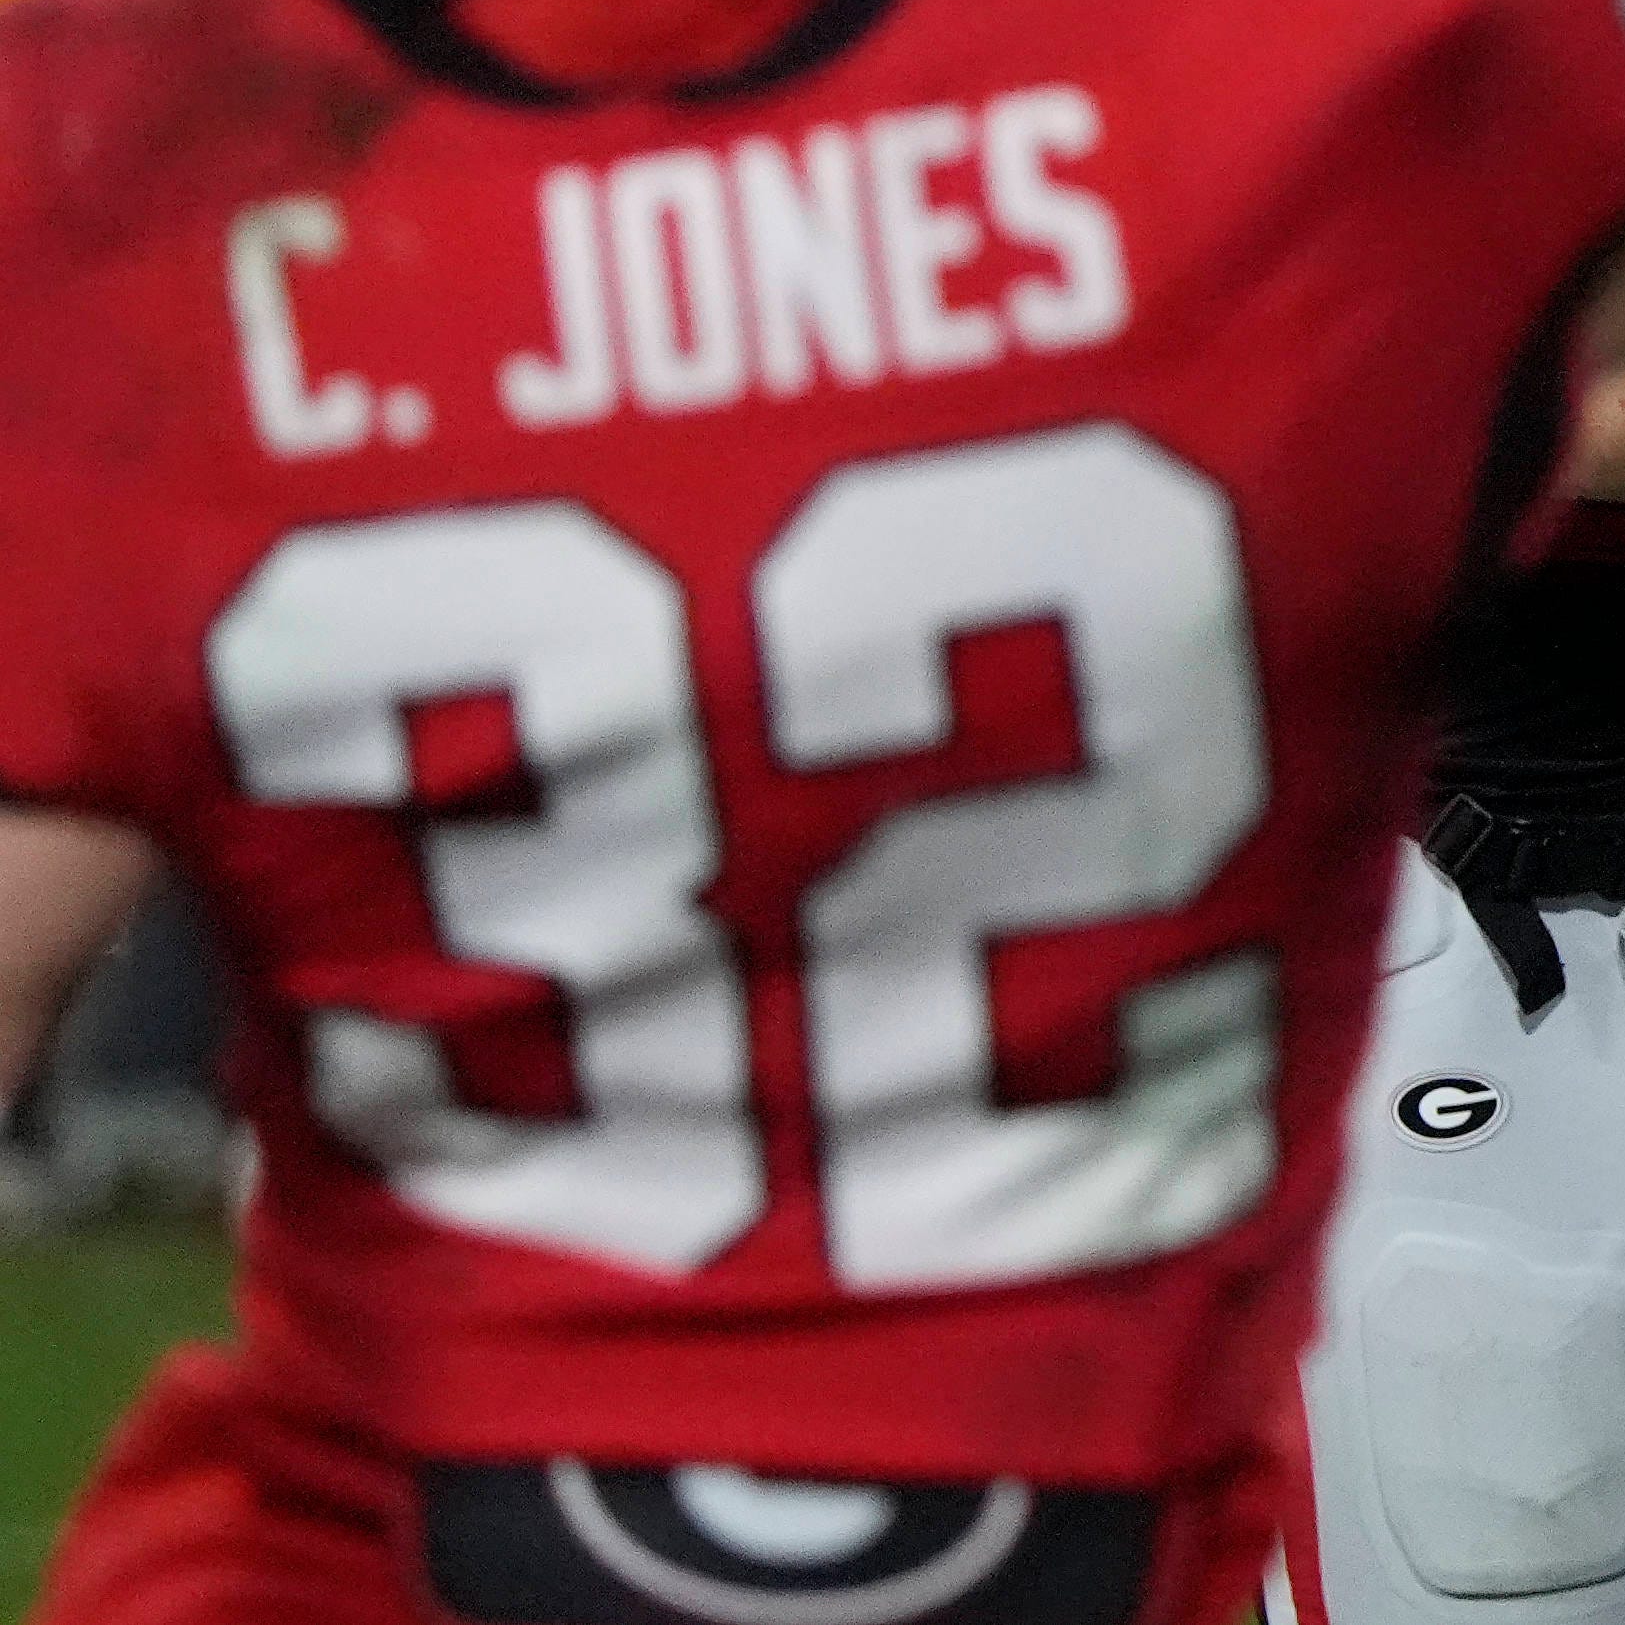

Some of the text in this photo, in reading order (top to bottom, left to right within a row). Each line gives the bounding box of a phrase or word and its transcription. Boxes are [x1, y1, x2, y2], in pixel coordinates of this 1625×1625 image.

[225, 83, 1131, 458] C. JONES
[203, 420, 1279, 1296] 32
[1398, 1078, 1498, 1139] G
